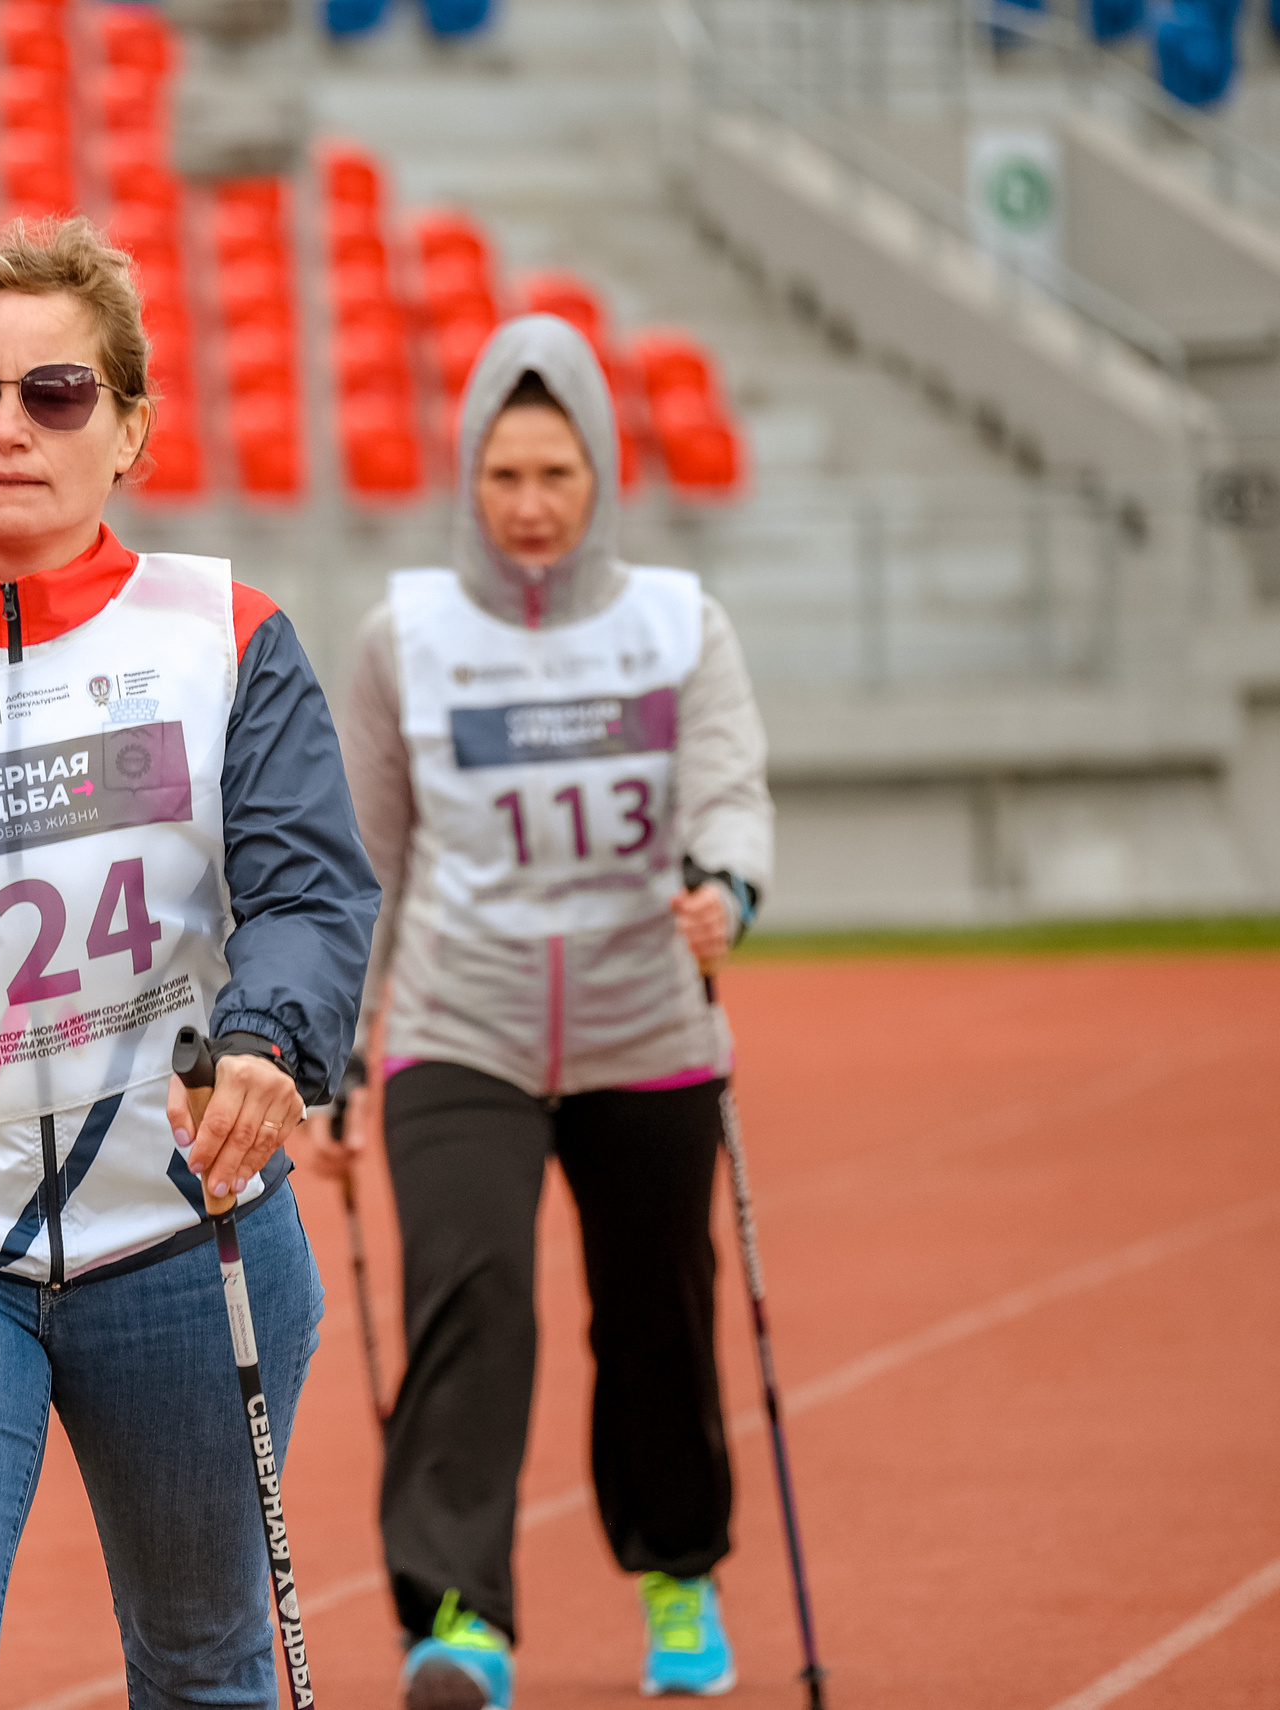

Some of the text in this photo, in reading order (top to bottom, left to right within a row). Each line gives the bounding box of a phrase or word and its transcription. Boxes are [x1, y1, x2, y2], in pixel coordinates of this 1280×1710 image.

[45, 807, 99, 830] ЖИЗНИ
[495, 779, 656, 865] 113
[247, 1393, 290, 1560] СЕВЕРНАЯ
